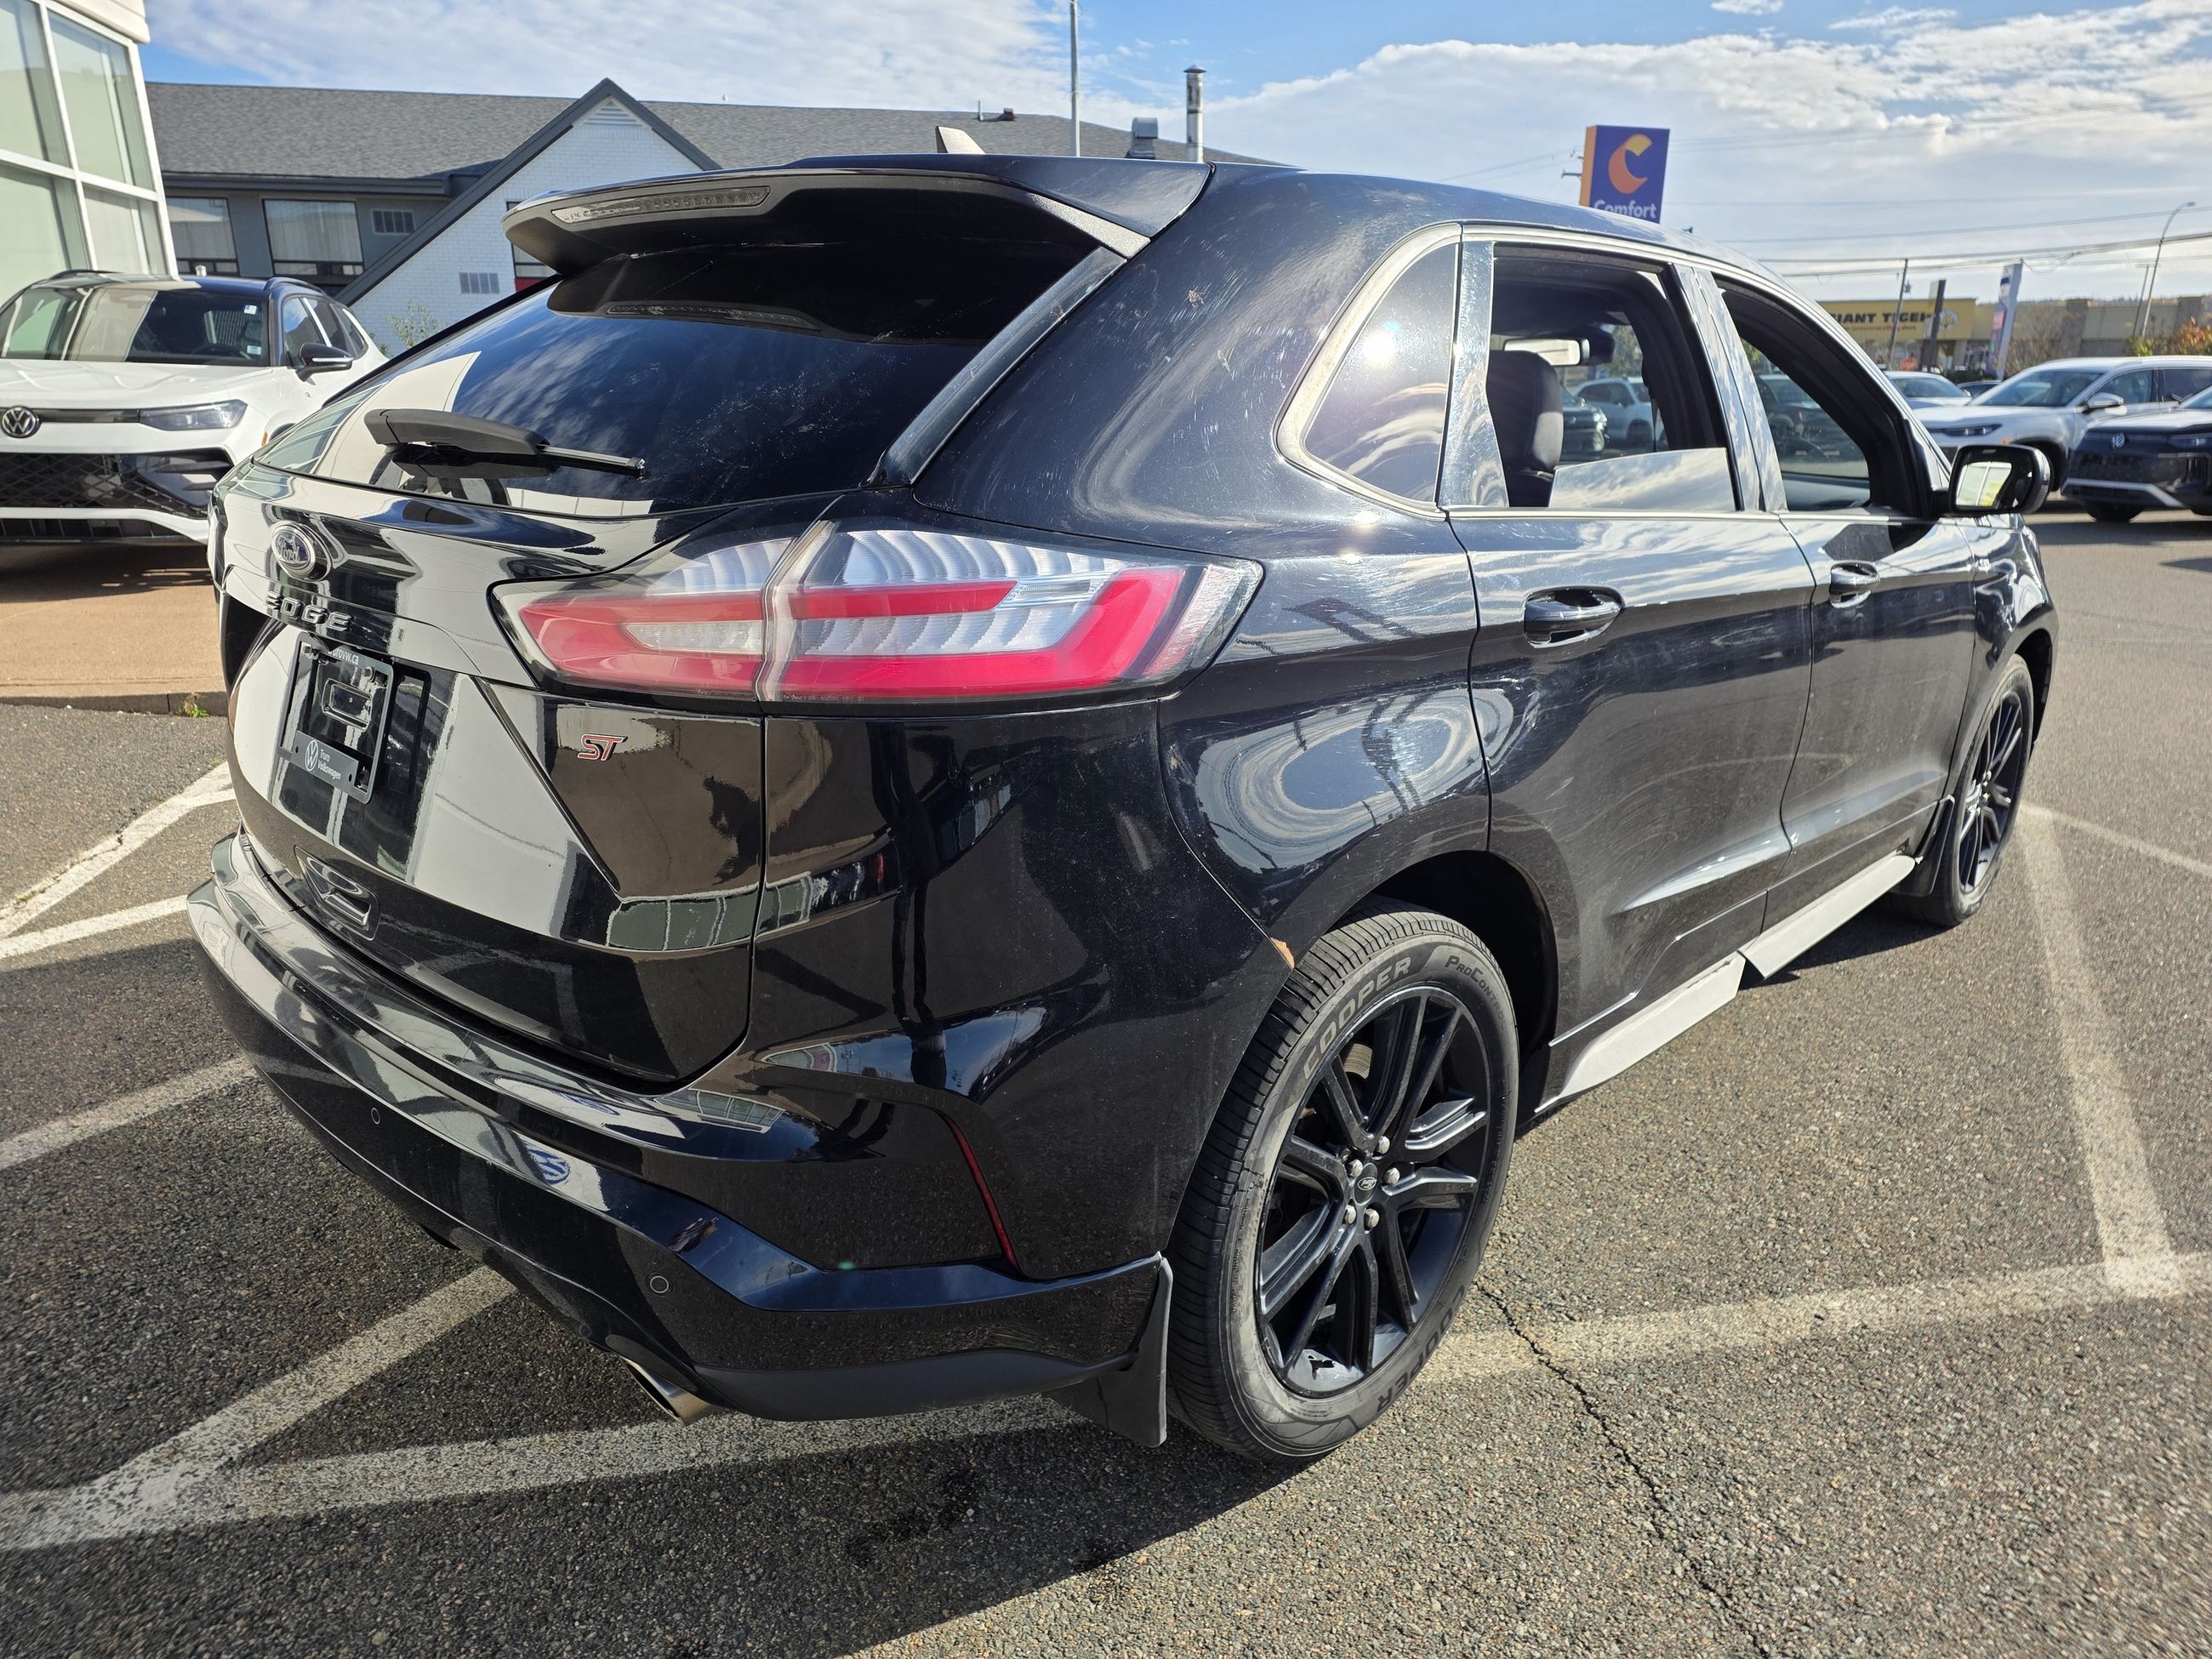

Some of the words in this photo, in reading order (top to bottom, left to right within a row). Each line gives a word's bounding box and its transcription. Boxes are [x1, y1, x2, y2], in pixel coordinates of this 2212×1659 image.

[265, 590, 353, 632] EDGE
[328, 647, 359, 665] urovw.ca
[577, 733, 625, 761] ST
[1303, 956, 1411, 1080] COOPER
